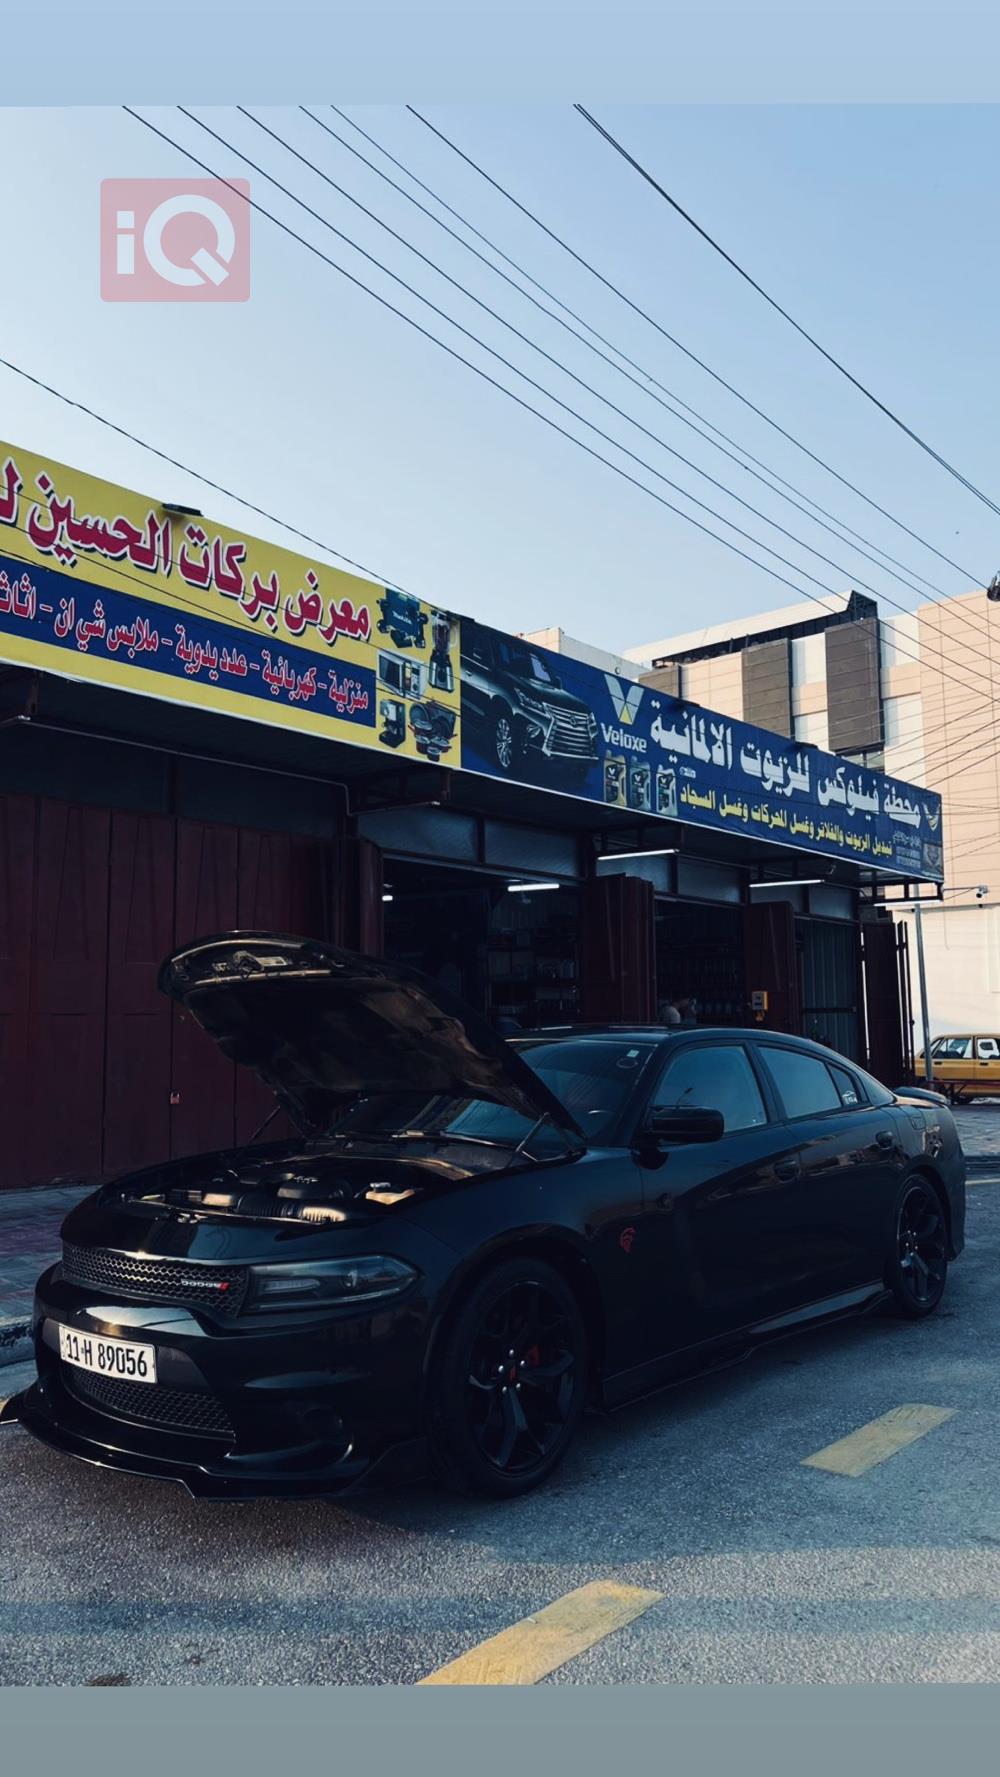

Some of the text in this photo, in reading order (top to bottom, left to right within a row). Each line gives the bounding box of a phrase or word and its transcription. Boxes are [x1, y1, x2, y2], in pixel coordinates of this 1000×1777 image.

[27, 471, 172, 576] الحسين
[179, 522, 279, 632] بركات
[54, 597, 75, 638] ان
[75, 599, 107, 652] شي
[284, 571, 371, 643] معرض
[106, 616, 159, 659] ملابس
[175, 624, 218, 681] يدوية
[219, 647, 248, 676] عدد
[261, 649, 317, 701] كهربائية
[328, 669, 369, 714] منزلية
[600, 722, 647, 753] Veloxe
[650, 700, 921, 829] محطة فيلوكس للزيوت الالمانية
[680, 783, 716, 810] السجاد
[719, 793, 748, 822] وغسل
[97, 1343, 147, 1377] 89056
